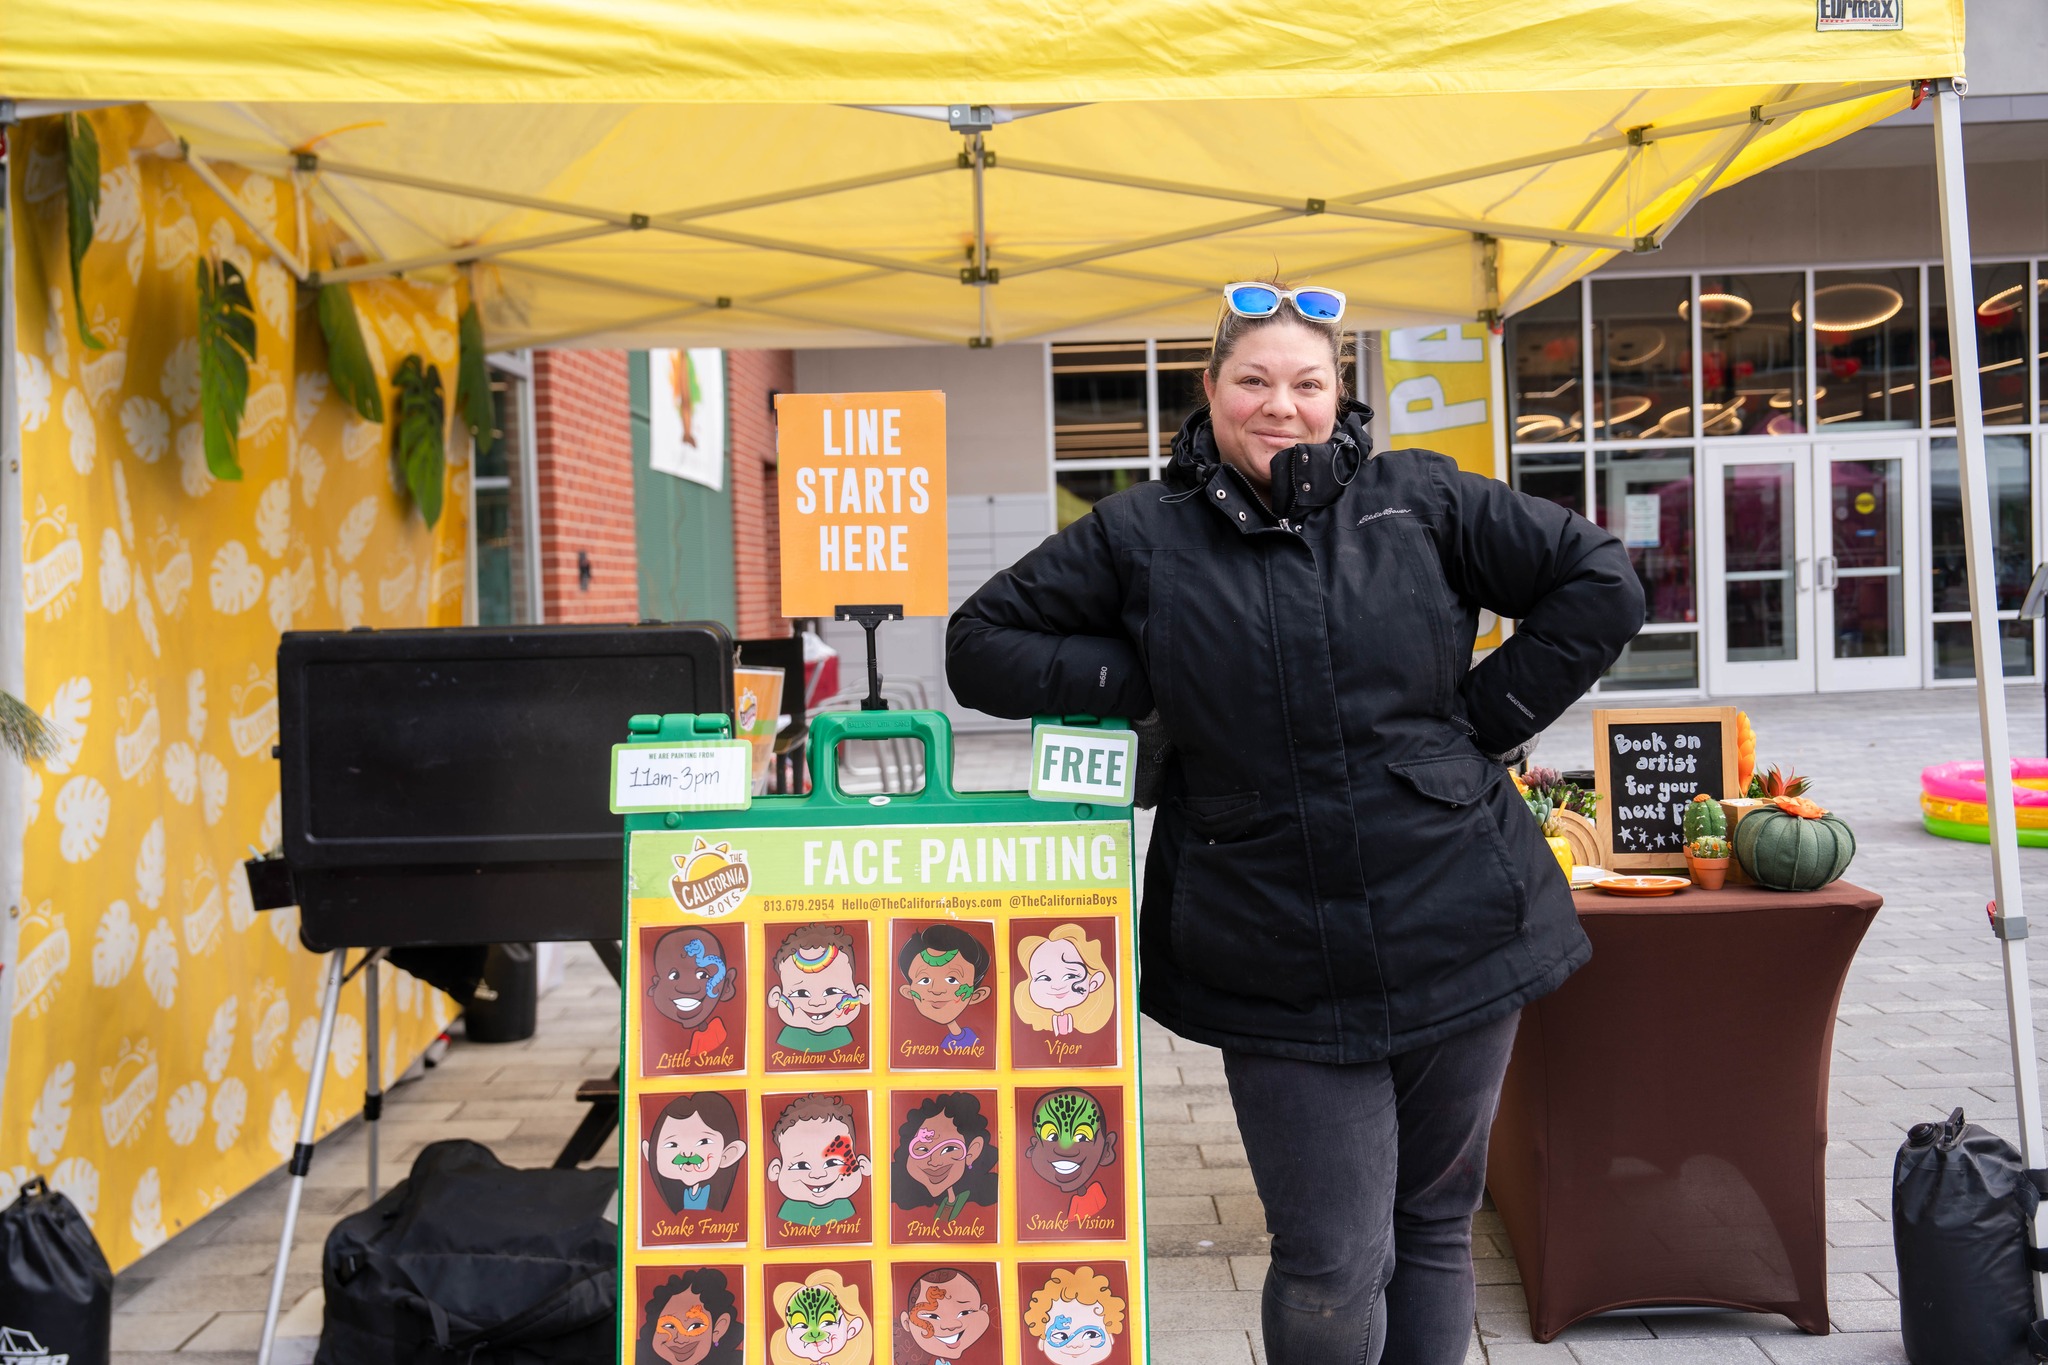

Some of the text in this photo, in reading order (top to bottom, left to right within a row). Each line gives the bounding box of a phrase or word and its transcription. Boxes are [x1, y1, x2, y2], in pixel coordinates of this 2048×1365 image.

[823, 409, 901, 456] LINE
[796, 466, 929, 515] STARTS
[819, 525, 909, 572] HERE
[1613, 731, 1701, 755] Book an
[648, 752, 657, 760] WE
[670, 751, 697, 759] PAINTING
[1042, 744, 1124, 786] FREE
[1635, 751, 1697, 774] artist
[1624, 774, 1698, 803] for your
[1618, 802, 1666, 821] next
[729, 852, 744, 863] THE
[804, 834, 1117, 886] FACE PAINTING
[681, 866, 746, 908] CALIFORNIA
[707, 891, 741, 916] BOYS
[763, 899, 835, 912] 813.679.2954
[1009, 893, 1118, 909] @TheCaliforniaBoys
[656, 1046, 735, 1069] Little Snake
[771, 1046, 866, 1066] Rainbow Snake
[900, 1037, 985, 1058] Green Snake
[1044, 1039, 1083, 1063] Viper
[651, 1216, 740, 1242] Snake Fangs
[778, 1216, 862, 1238] Snake Print
[907, 1217, 985, 1239] Pink Snake
[1026, 1210, 1116, 1232] Snake Vision
